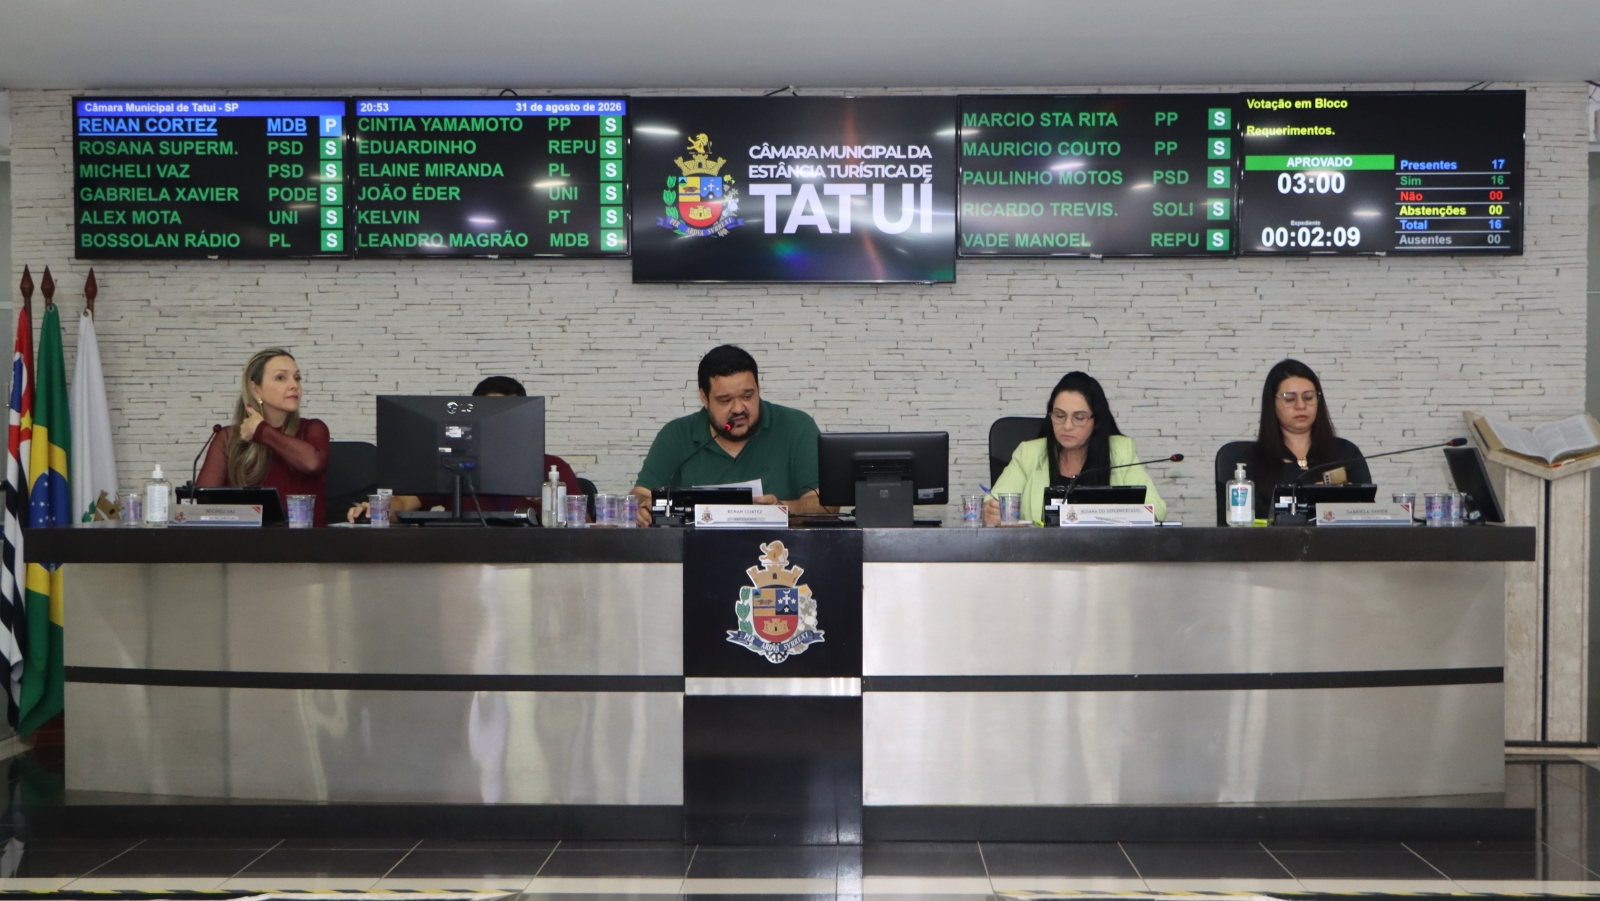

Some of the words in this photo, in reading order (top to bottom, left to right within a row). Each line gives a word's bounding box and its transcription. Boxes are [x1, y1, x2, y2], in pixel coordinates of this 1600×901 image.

[85, 103, 123, 112] Câmara
[125, 103, 174, 115] Municipal
[177, 103, 189, 112] de
[225, 103, 239, 112] SP
[360, 103, 389, 112] 20:53
[516, 103, 528, 112] 31
[531, 103, 543, 112] de
[545, 103, 580, 114] agosto
[583, 103, 595, 112] de
[598, 102, 621, 112] 2026
[1247, 99, 1292, 111] Votação
[1294, 101, 1312, 109] em
[1315, 99, 1347, 109] Bloco
[79, 118, 140, 132] RENAN
[146, 118, 217, 132] CORTEZ
[267, 118, 307, 132] MDB
[325, 118, 337, 132] P
[358, 118, 416, 131] CINTIA
[420, 118, 523, 131] YAMAMOTO
[549, 118, 571, 131] PP
[605, 118, 617, 132] S
[963, 113, 1034, 127] MARCIO
[1040, 113, 1073, 126] STA
[1079, 112, 1118, 126] RITA
[1155, 112, 1178, 125] PP
[1214, 112, 1225, 125] S
[1247, 126, 1335, 137] Requerimentos.
[79, 141, 154, 155] ROSANA
[159, 141, 238, 155] SUPERM.
[268, 141, 303, 155] PSD
[325, 142, 336, 155] S
[359, 140, 476, 154] EDUARDINHO
[549, 140, 596, 154] REPU
[605, 141, 617, 155] S
[749, 142, 817, 159] CÂMARA
[820, 146, 906, 159] MUNICIPAL
[908, 145, 932, 159] DA
[963, 142, 1052, 156] MAURICIO
[1058, 142, 1121, 155] COUTO
[1155, 142, 1178, 155] PP
[1214, 141, 1225, 155] S
[1287, 157, 1352, 168] APROVADO
[1401, 160, 1457, 170] Presentes
[1492, 160, 1505, 169] 17
[80, 164, 150, 178] MICHELI
[157, 164, 190, 178] VAZ
[268, 165, 303, 178] PSD
[326, 165, 337, 178] S
[359, 163, 419, 177] ELAINE
[425, 163, 504, 177] MIRANDA
[549, 164, 570, 177] PL
[606, 163, 617, 177] S
[749, 162, 825, 178] ESTÂNCIA
[827, 162, 907, 178] TURÍSTICA
[910, 165, 932, 178] DE
[963, 171, 1053, 185] PAULINHO
[1059, 171, 1122, 185] MOTOS
[1153, 171, 1189, 184] PSD
[1213, 170, 1224, 184] S
[1278, 173, 1345, 194] 03:00
[1400, 176, 1421, 186] Sim
[1491, 175, 1504, 185] 16
[80, 188, 170, 201] GABRIELA
[176, 188, 239, 201] XAVIER
[269, 188, 317, 201] PODE
[326, 188, 337, 201] S
[358, 184, 407, 201] JOÃO
[413, 184, 460, 200] ÉDER
[549, 187, 578, 200] UNI
[606, 186, 617, 200] S
[1401, 192, 1422, 201] Não
[1490, 191, 1502, 200] 00
[749, 177, 932, 234] TATUÍ
[963, 203, 1044, 216] RICARDO
[1050, 203, 1118, 216] TREVIS.
[1153, 203, 1193, 216] SOLI
[1213, 202, 1224, 216] S
[1400, 206, 1466, 217] Abstenções
[1489, 206, 1502, 215] 00
[81, 211, 126, 224] ALEX
[132, 211, 181, 224] MOTA
[269, 211, 298, 224] UNI
[326, 211, 337, 224] S
[358, 211, 419, 224] KELVIN
[549, 211, 570, 224] PT
[606, 210, 617, 224] S
[1400, 220, 1427, 230] Total
[1489, 220, 1501, 229] 16
[82, 234, 178, 247] BOSSOLAN
[185, 231, 240, 247] RÁDIO
[270, 234, 291, 247] PL
[326, 234, 337, 247] S
[359, 234, 443, 247] LEANDRO
[450, 230, 528, 247] MAGRÃO
[550, 234, 589, 247] MDB
[606, 233, 617, 247] S
[962, 234, 1009, 247] VADE
[1015, 233, 1091, 247] MANOEL
[1151, 233, 1199, 247] REPU
[1212, 233, 1223, 246] S
[1262, 227, 1360, 247] 00:02:09
[1400, 235, 1452, 245] Ausentes
[1487, 235, 1500, 244] 00
[744, 633, 755, 643] PER
